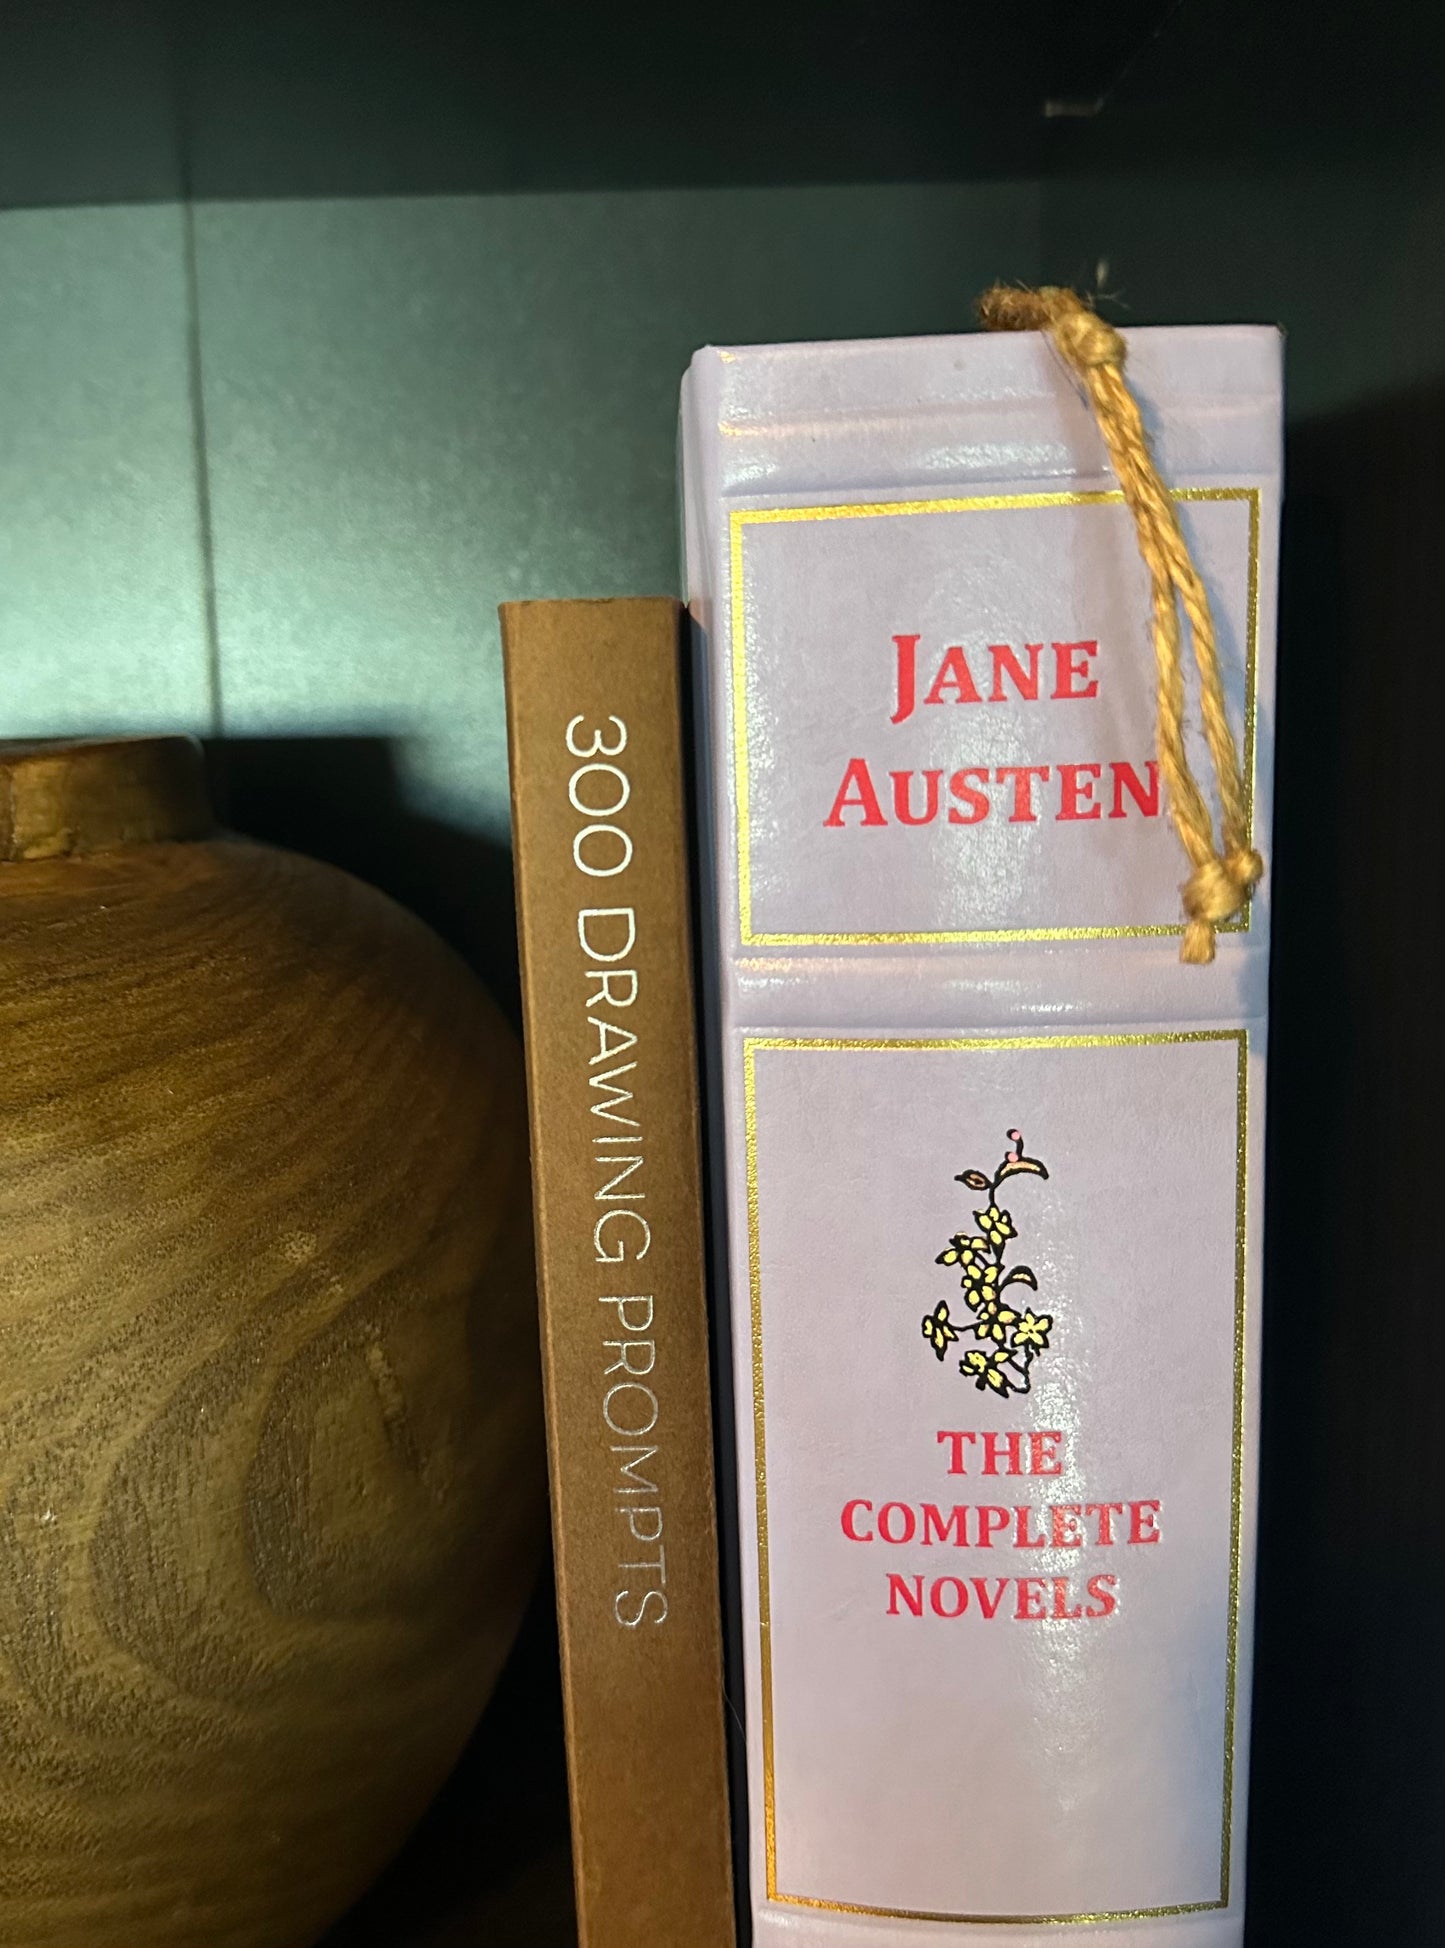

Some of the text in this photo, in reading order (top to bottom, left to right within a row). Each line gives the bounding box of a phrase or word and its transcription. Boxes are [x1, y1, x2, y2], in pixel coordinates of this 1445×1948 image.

[891, 634, 1100, 725] JANE
[823, 757, 1160, 828] AUSTEN
[563, 713, 668, 1629] 300 DRAWING PROMPTS
[936, 1430, 1063, 1477] THE
[839, 1498, 1162, 1549] COMPLETE
[886, 1573, 1119, 1621] NOVELS
